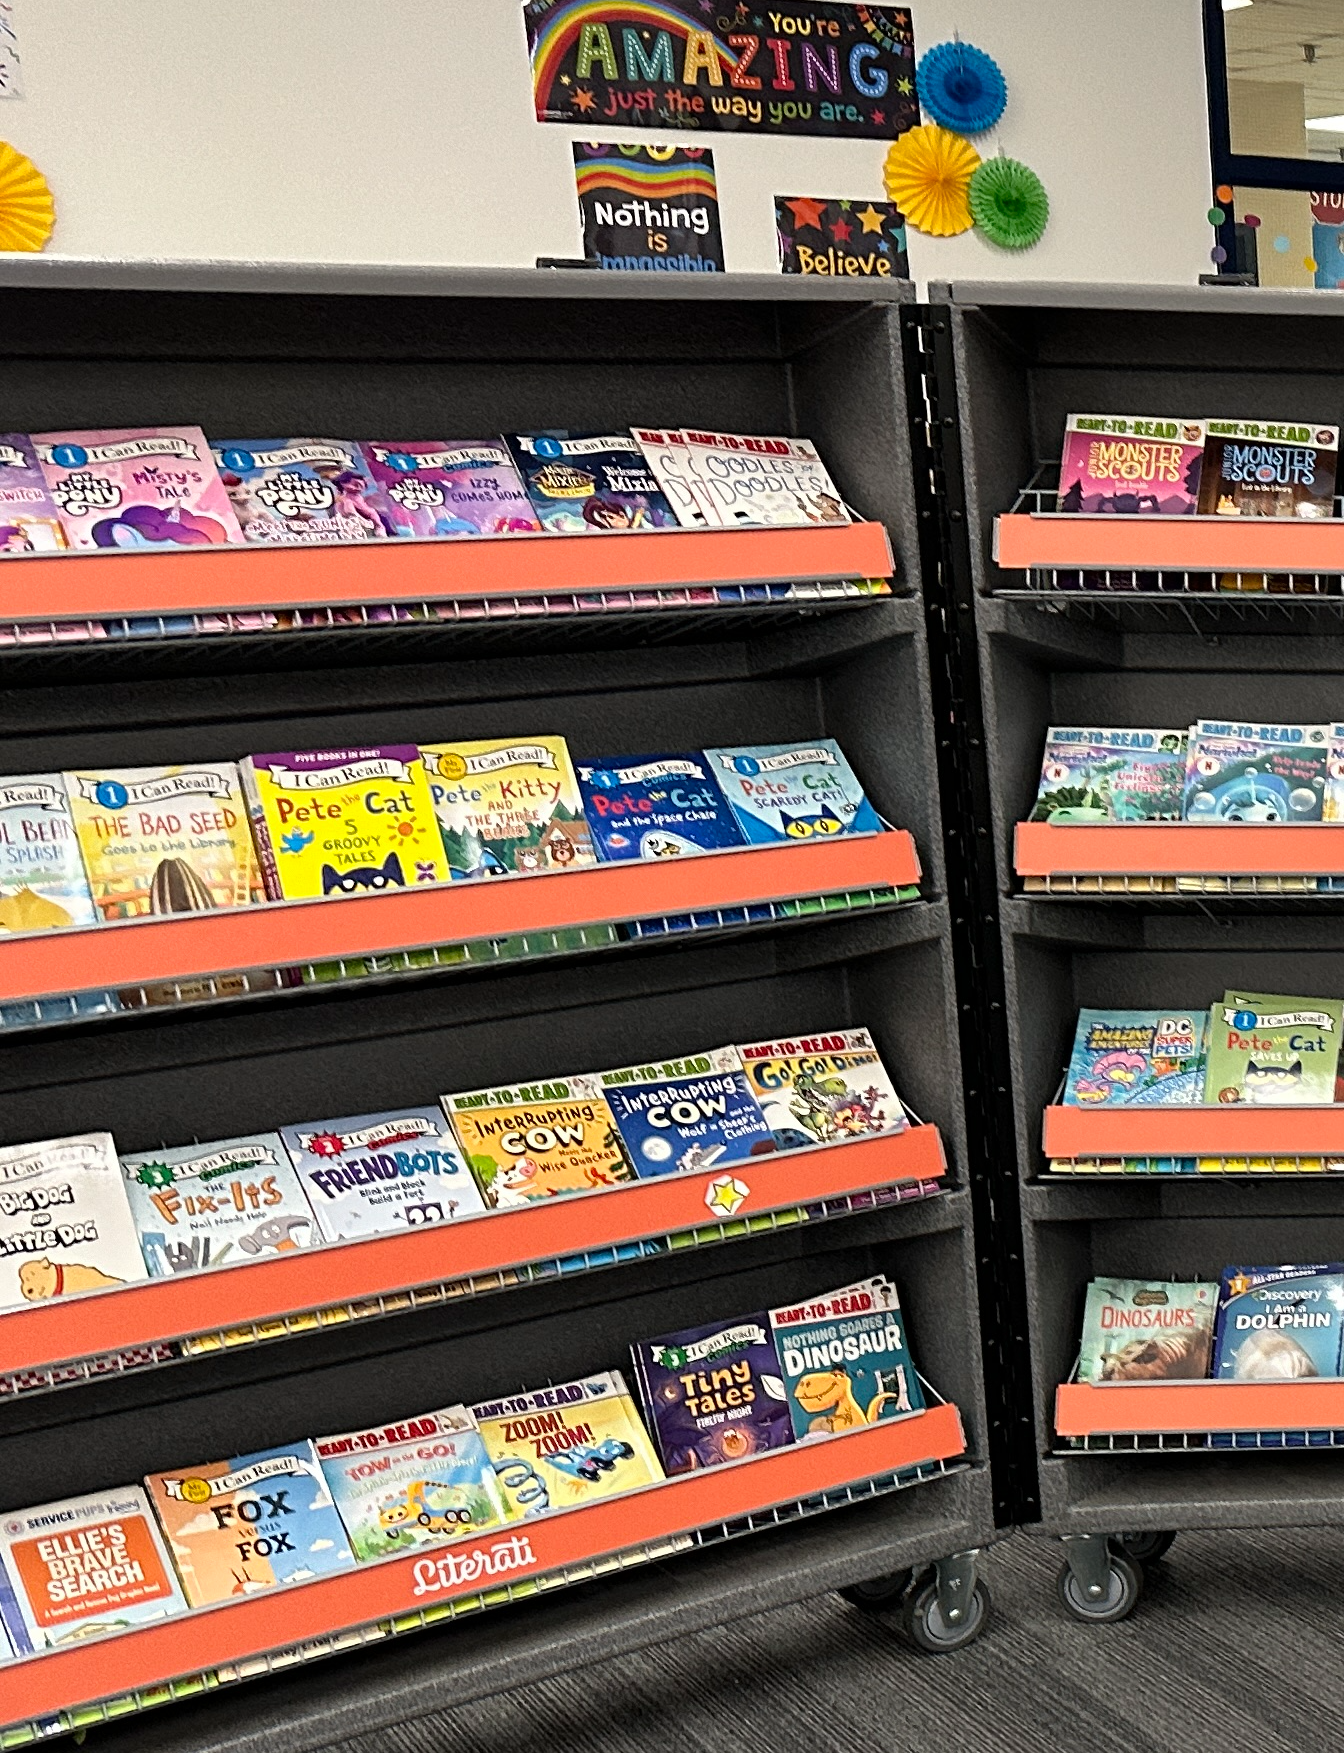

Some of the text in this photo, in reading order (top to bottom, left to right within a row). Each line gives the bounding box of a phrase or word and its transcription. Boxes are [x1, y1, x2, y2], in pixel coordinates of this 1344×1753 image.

[769, 13, 840, 38] You're
[576, 23, 888, 98] AMAZING
[604, 89, 864, 123] just the way you are.
[595, 202, 709, 235] Nothing
[648, 230, 667, 253] is
[798, 246, 890, 277] Believe
[64, 439, 180, 465] 1 Can Read!
[267, 449, 297, 466] Can
[1100, 442, 1183, 465] MONSTER
[1233, 444, 1316, 467] MONSTER
[71, 472, 92, 484] MY
[1096, 460, 1180, 482] SCOUTS
[1232, 463, 1315, 485] SCOUTS
[57, 480, 111, 493] LITTLE
[53, 486, 122, 515] PONY
[258, 488, 333, 516] PONY
[305, 761, 390, 787] Can Read!
[740, 773, 841, 797] Pete Cat
[106, 777, 216, 805] 1 Can Read!
[432, 779, 561, 805] Pete Kitty
[592, 789, 718, 816] Pete Cat
[276, 791, 415, 823] Pete the Cat
[465, 809, 540, 826] THE THREE
[488, 800, 514, 812] AND
[89, 808, 237, 839] THE BAD SEED
[346, 819, 358, 835] 5
[101, 839, 185, 856] Goes to the
[322, 835, 381, 852] GROOVY
[334, 850, 376, 866] TALES
[1161, 1018, 1192, 1036] DC
[1227, 1032, 1327, 1052] Pete Cat
[646, 1096, 728, 1129] COW
[499, 1124, 586, 1156] COW
[0, 1183, 75, 1215] BIG DOG
[57, 1220, 99, 1247] DOG
[1256, 1287, 1322, 1302] Discovery
[1101, 1306, 1195, 1329] DINOSAURS
[1235, 1313, 1331, 1329] DOLPHIN
[783, 1314, 895, 1350] NOTHING SCARES A
[783, 1325, 903, 1377] DINOSAUR
[680, 1360, 751, 1398] Tiny
[685, 1383, 755, 1418] Tales
[499, 1412, 566, 1443] ZOOM!
[529, 1424, 596, 1459] ZOOM!
[26, 1513, 75, 1530] SERVICE
[210, 1491, 296, 1530] FOX
[38, 1526, 126, 1562] ELLIE'S
[236, 1533, 296, 1562] FOX
[48, 1544, 130, 1579] BRAVE
[413, 1537, 537, 1596] Literati
[46, 1559, 143, 1602] SEARCH
